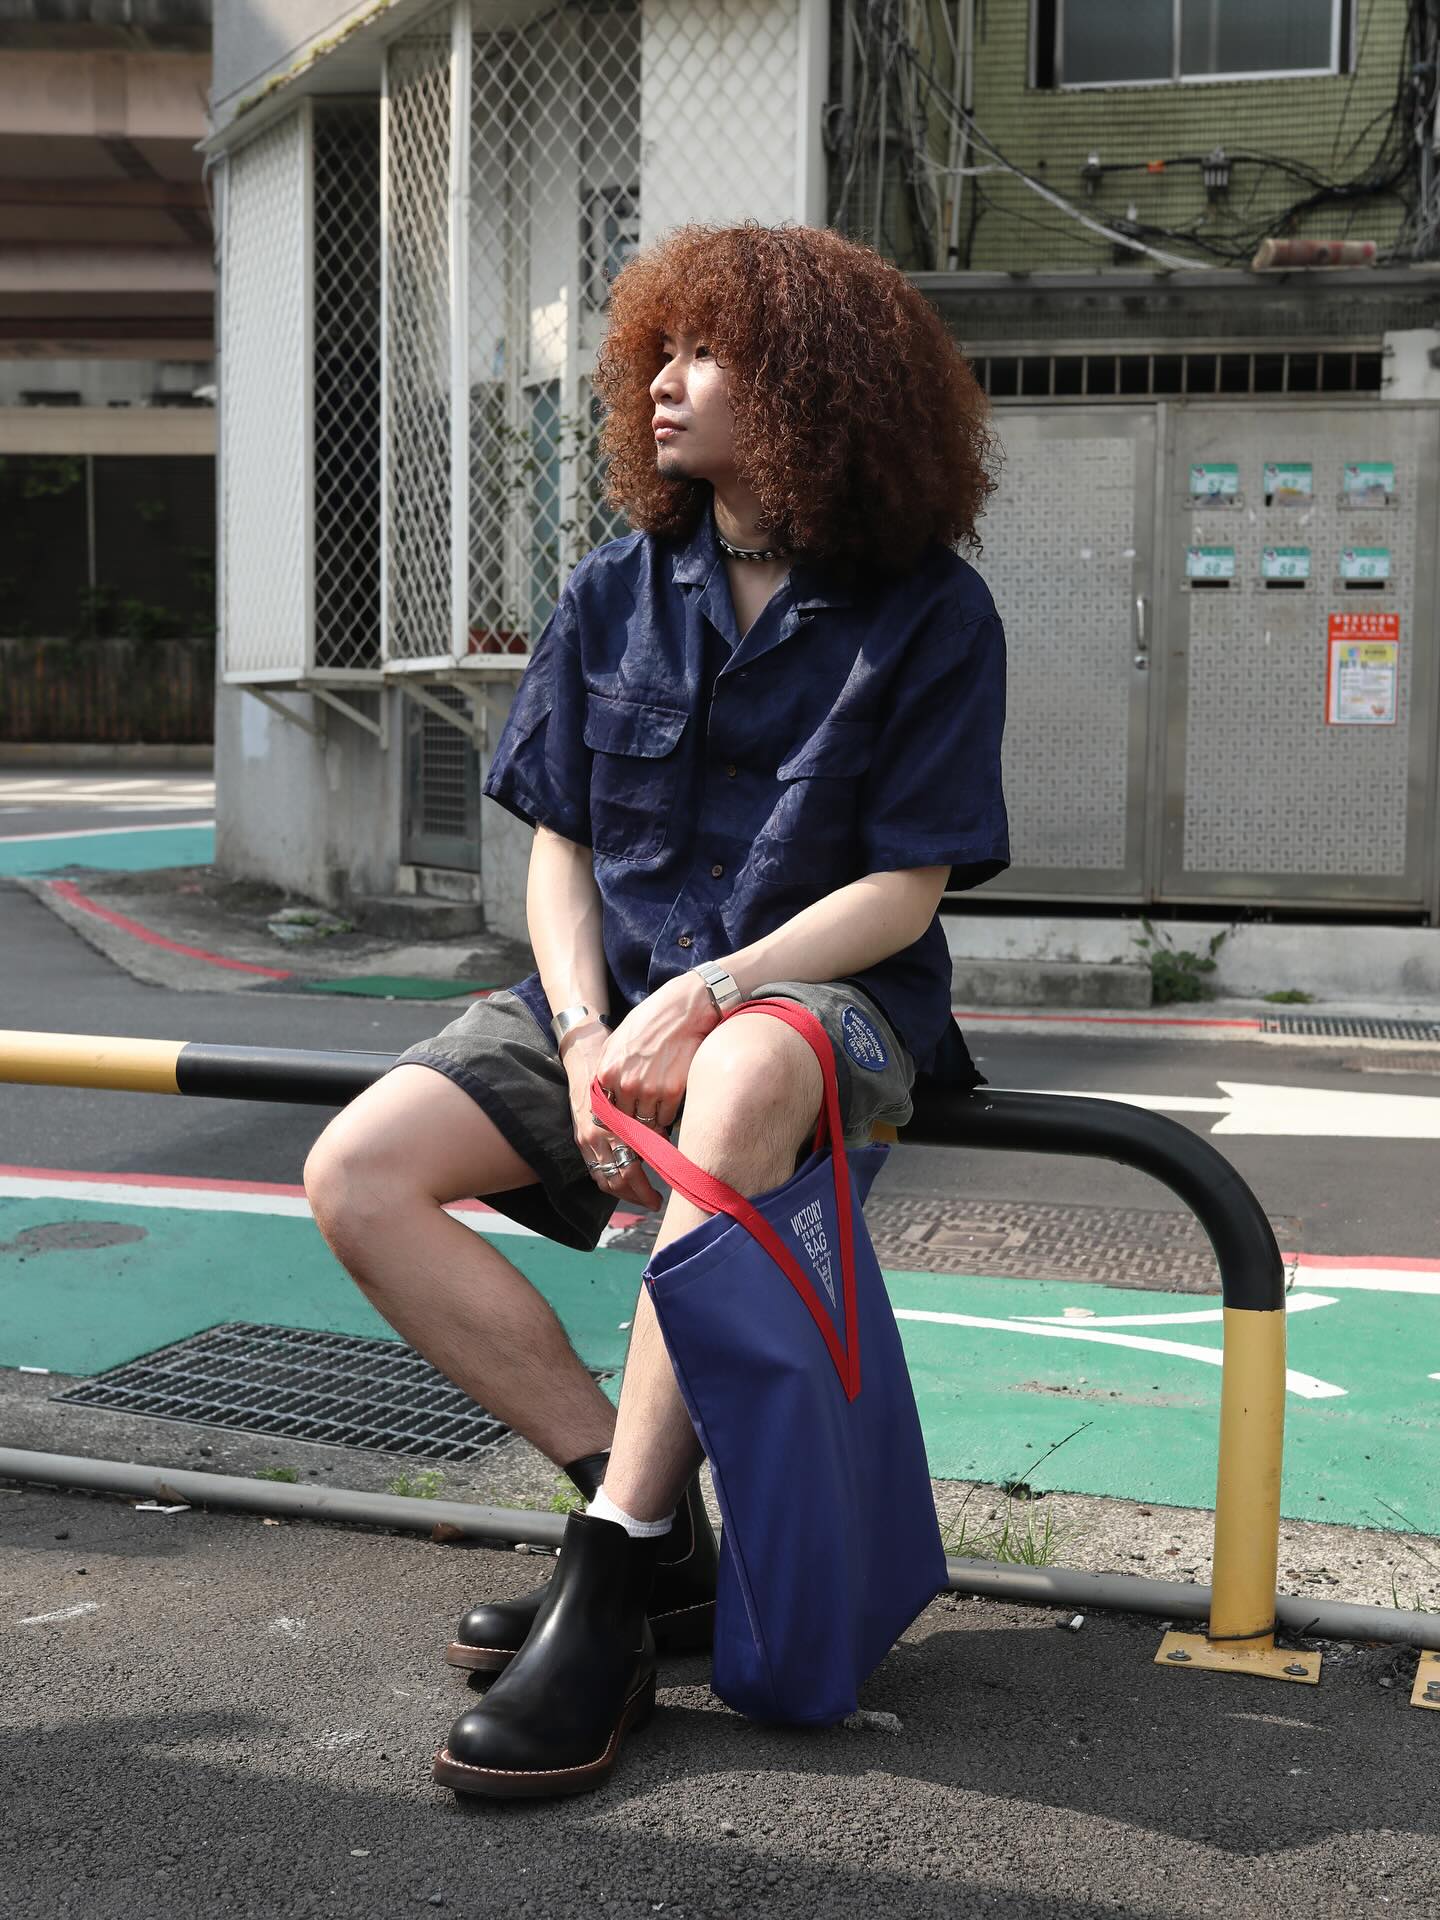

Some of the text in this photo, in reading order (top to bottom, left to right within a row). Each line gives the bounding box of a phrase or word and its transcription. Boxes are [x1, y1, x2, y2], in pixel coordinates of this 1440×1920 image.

[846, 1024, 870, 1062] INTEGRITY
[850, 1011, 884, 1062] NIGEL CABOURN
[852, 1021, 875, 1057] PRODUCTS
[790, 1199, 822, 1236] VICTORY
[804, 1232, 827, 1260] BAG
